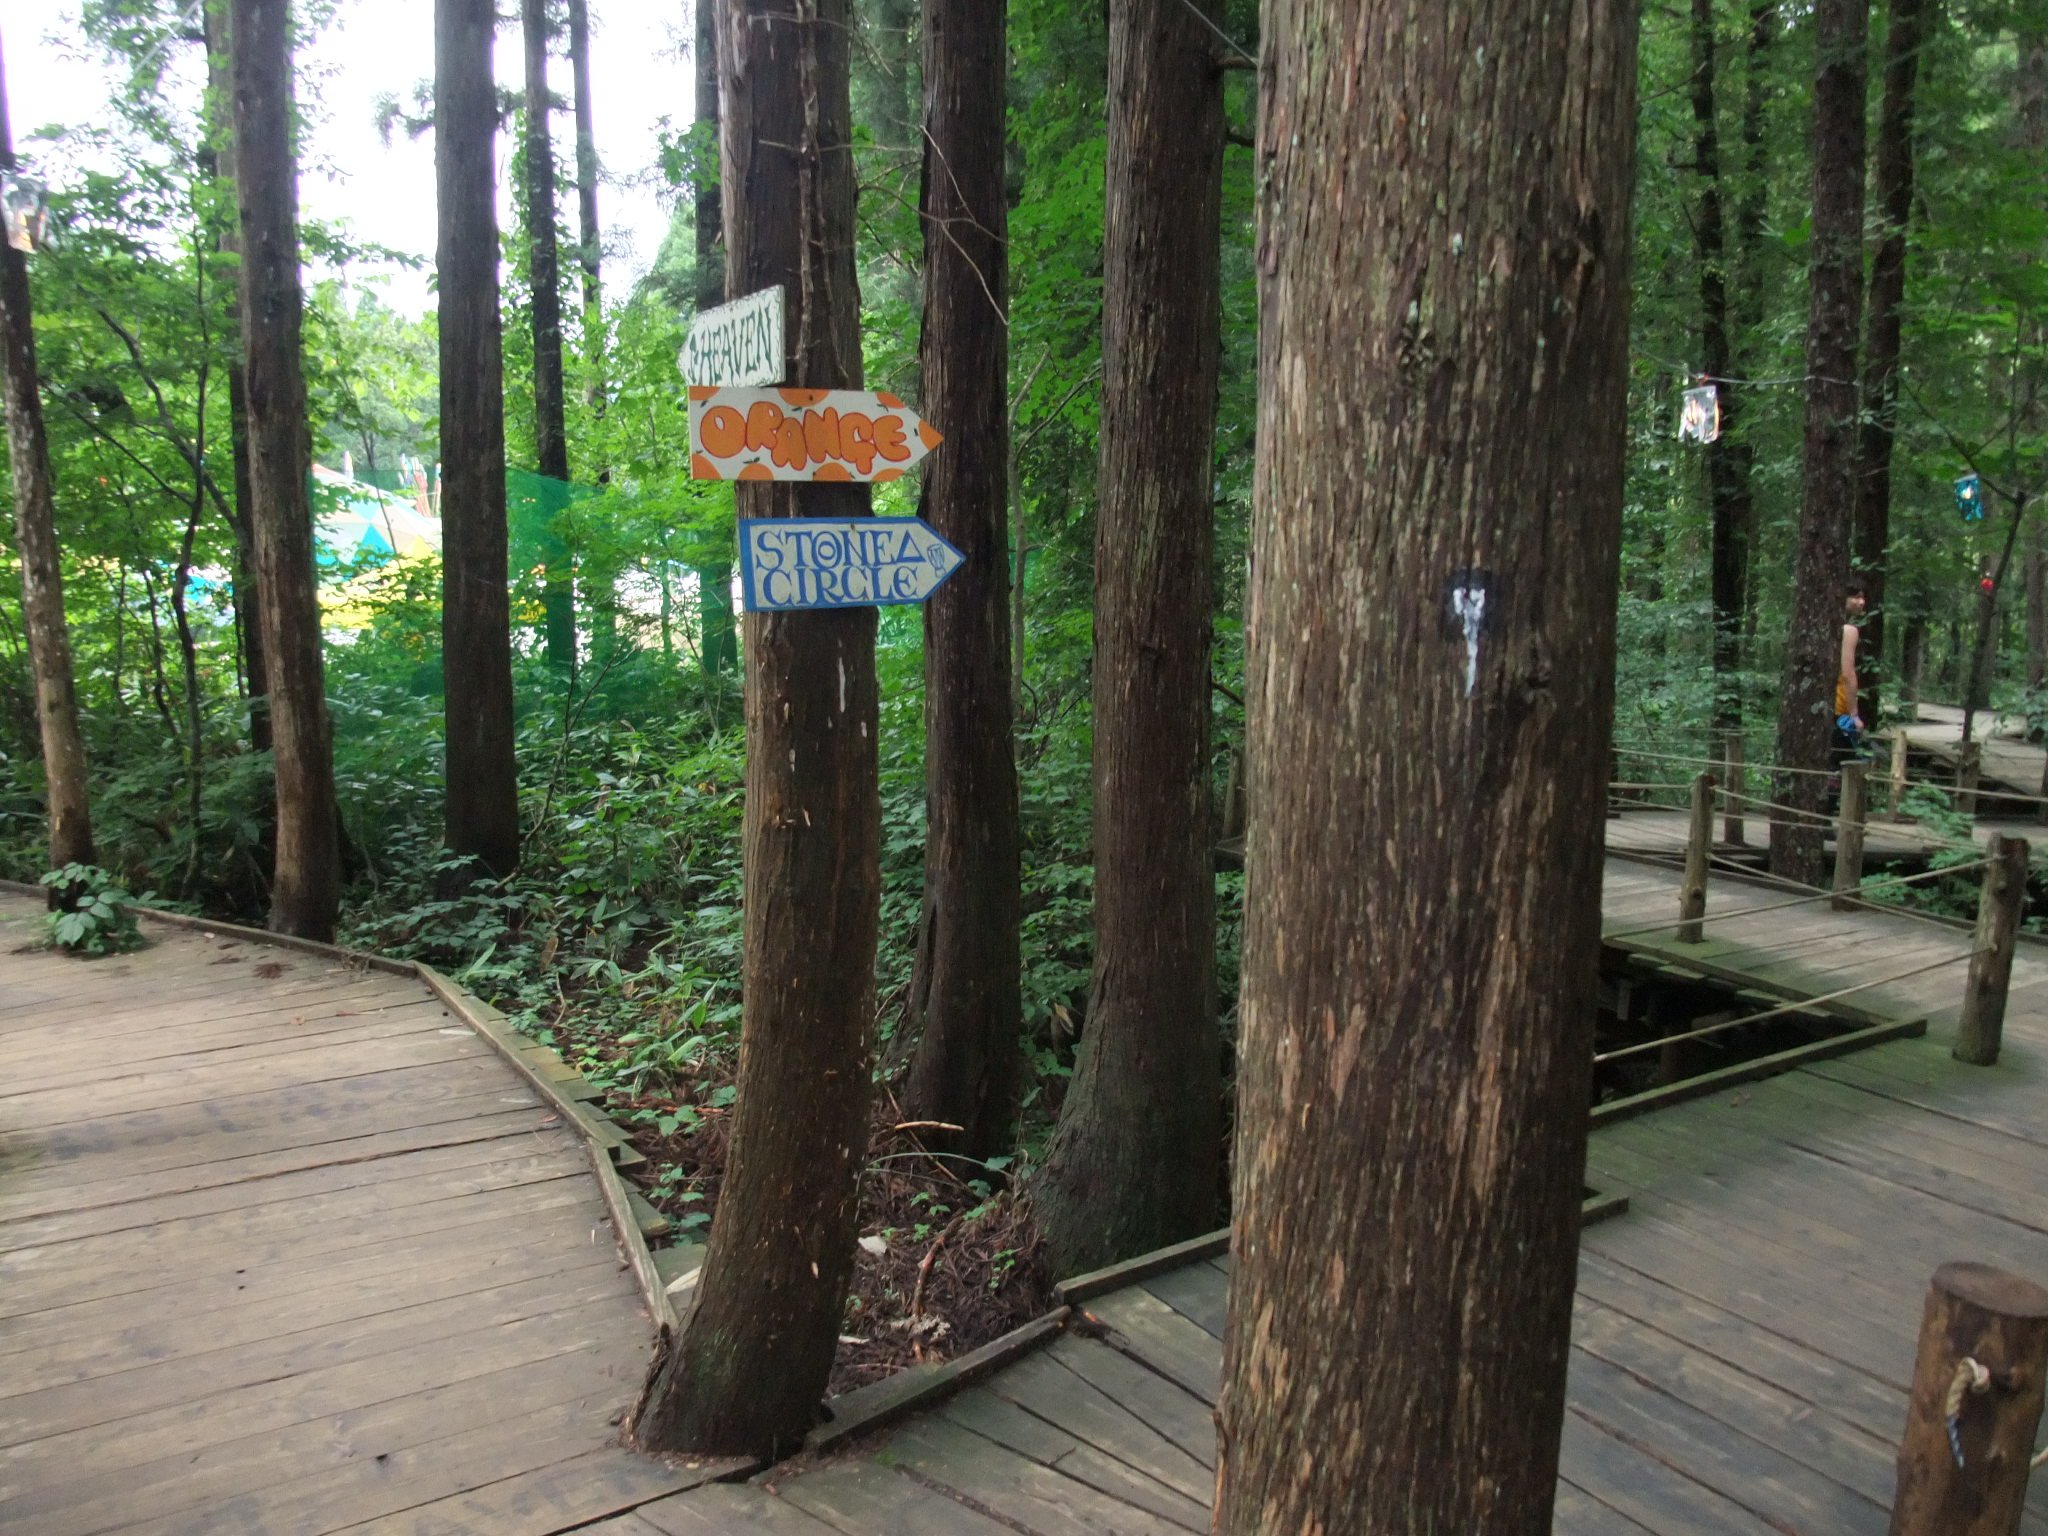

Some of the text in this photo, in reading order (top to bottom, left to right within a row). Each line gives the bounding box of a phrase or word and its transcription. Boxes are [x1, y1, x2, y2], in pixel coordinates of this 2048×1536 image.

[699, 303, 773, 386] HEAVEN
[700, 401, 911, 474] ORANGE
[756, 529, 896, 569] STONE
[762, 566, 918, 606] CIRCLE
